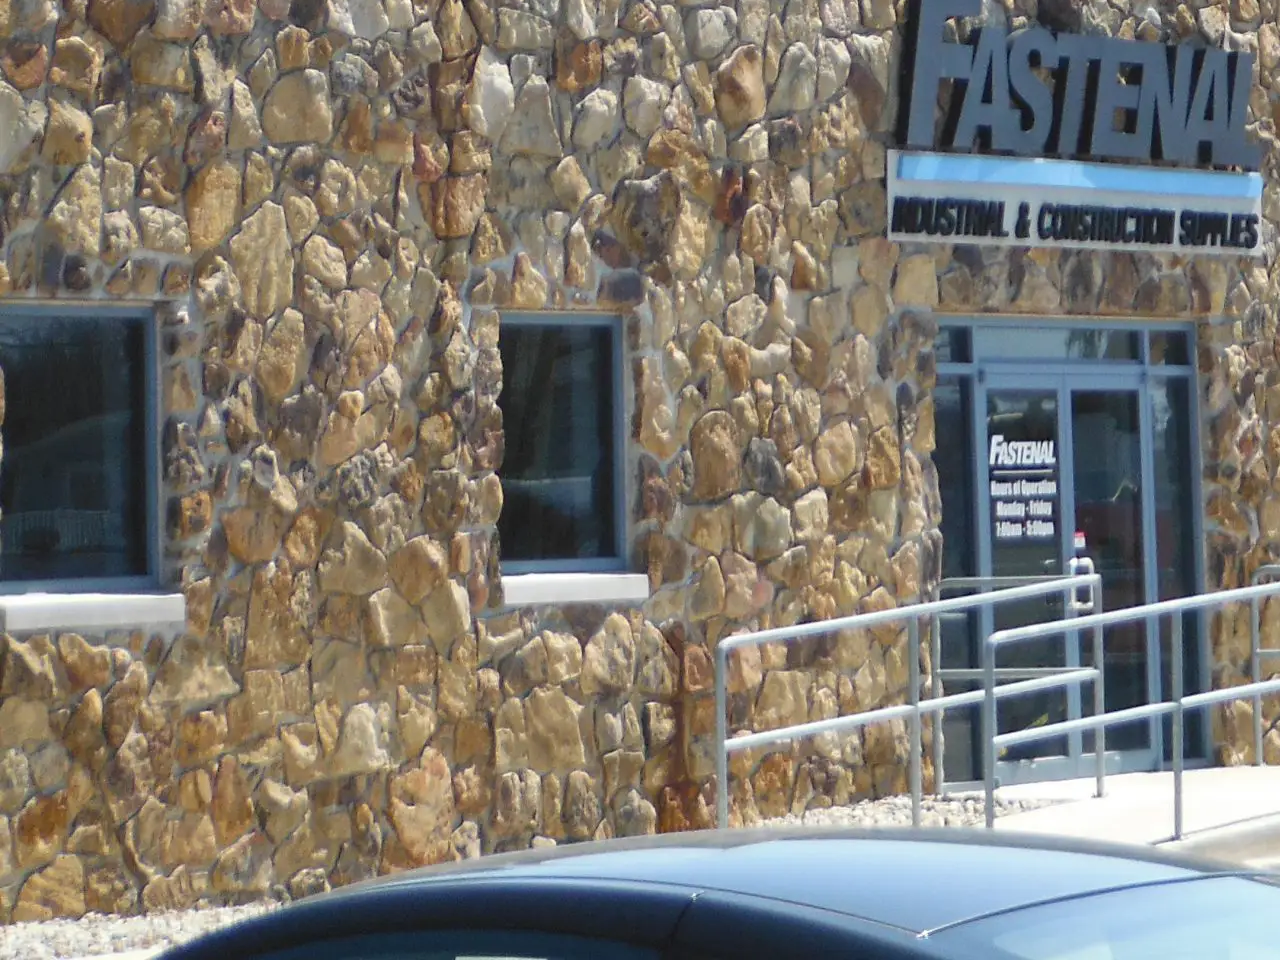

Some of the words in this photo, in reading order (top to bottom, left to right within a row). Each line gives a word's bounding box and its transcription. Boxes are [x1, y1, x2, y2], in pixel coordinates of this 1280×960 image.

[892, 195, 1009, 237] INDUSTRIAL
[1015, 201, 1031, 238] &
[1037, 202, 1176, 244] CONSTRUCTION
[1180, 209, 1259, 249] SUPPLIES
[989, 435, 1056, 464] FASTENAL
